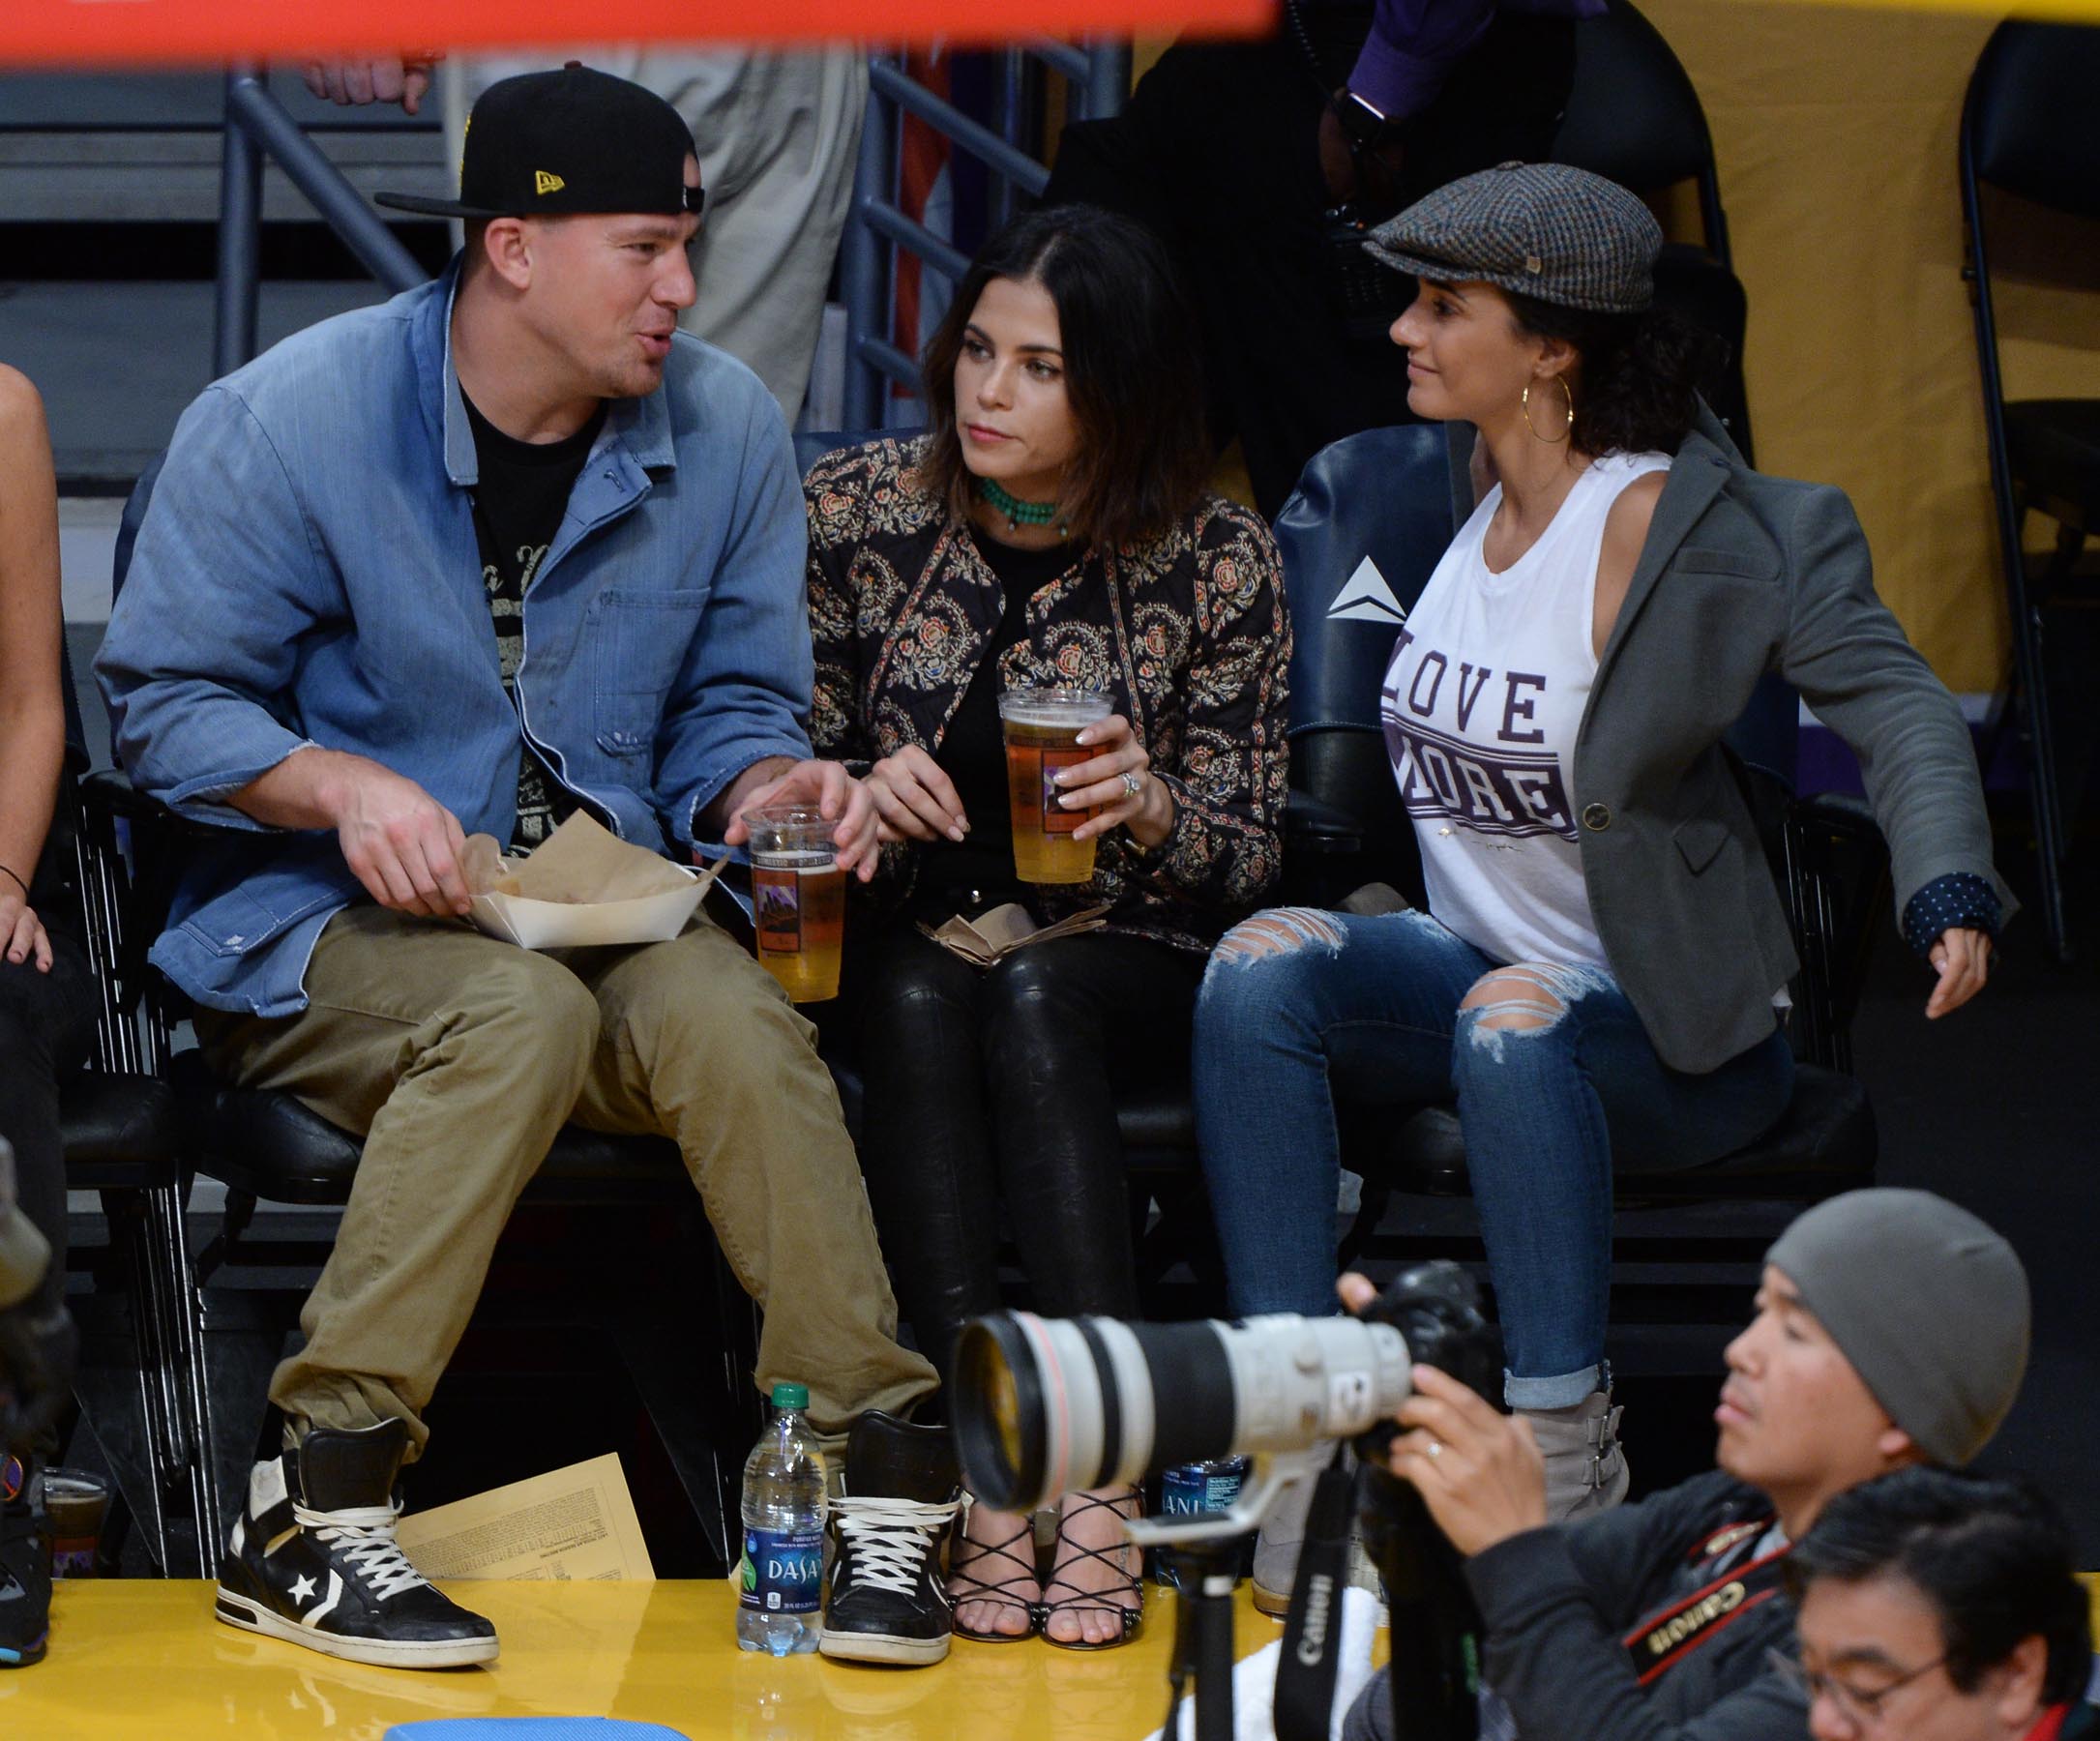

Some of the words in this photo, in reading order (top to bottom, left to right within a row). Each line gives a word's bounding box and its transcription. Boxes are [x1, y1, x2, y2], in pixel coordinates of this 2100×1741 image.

[1381, 629, 1546, 744] LOVE
[1297, 1574, 1333, 1667] Canon
[1648, 1581, 1745, 1654] Canon
